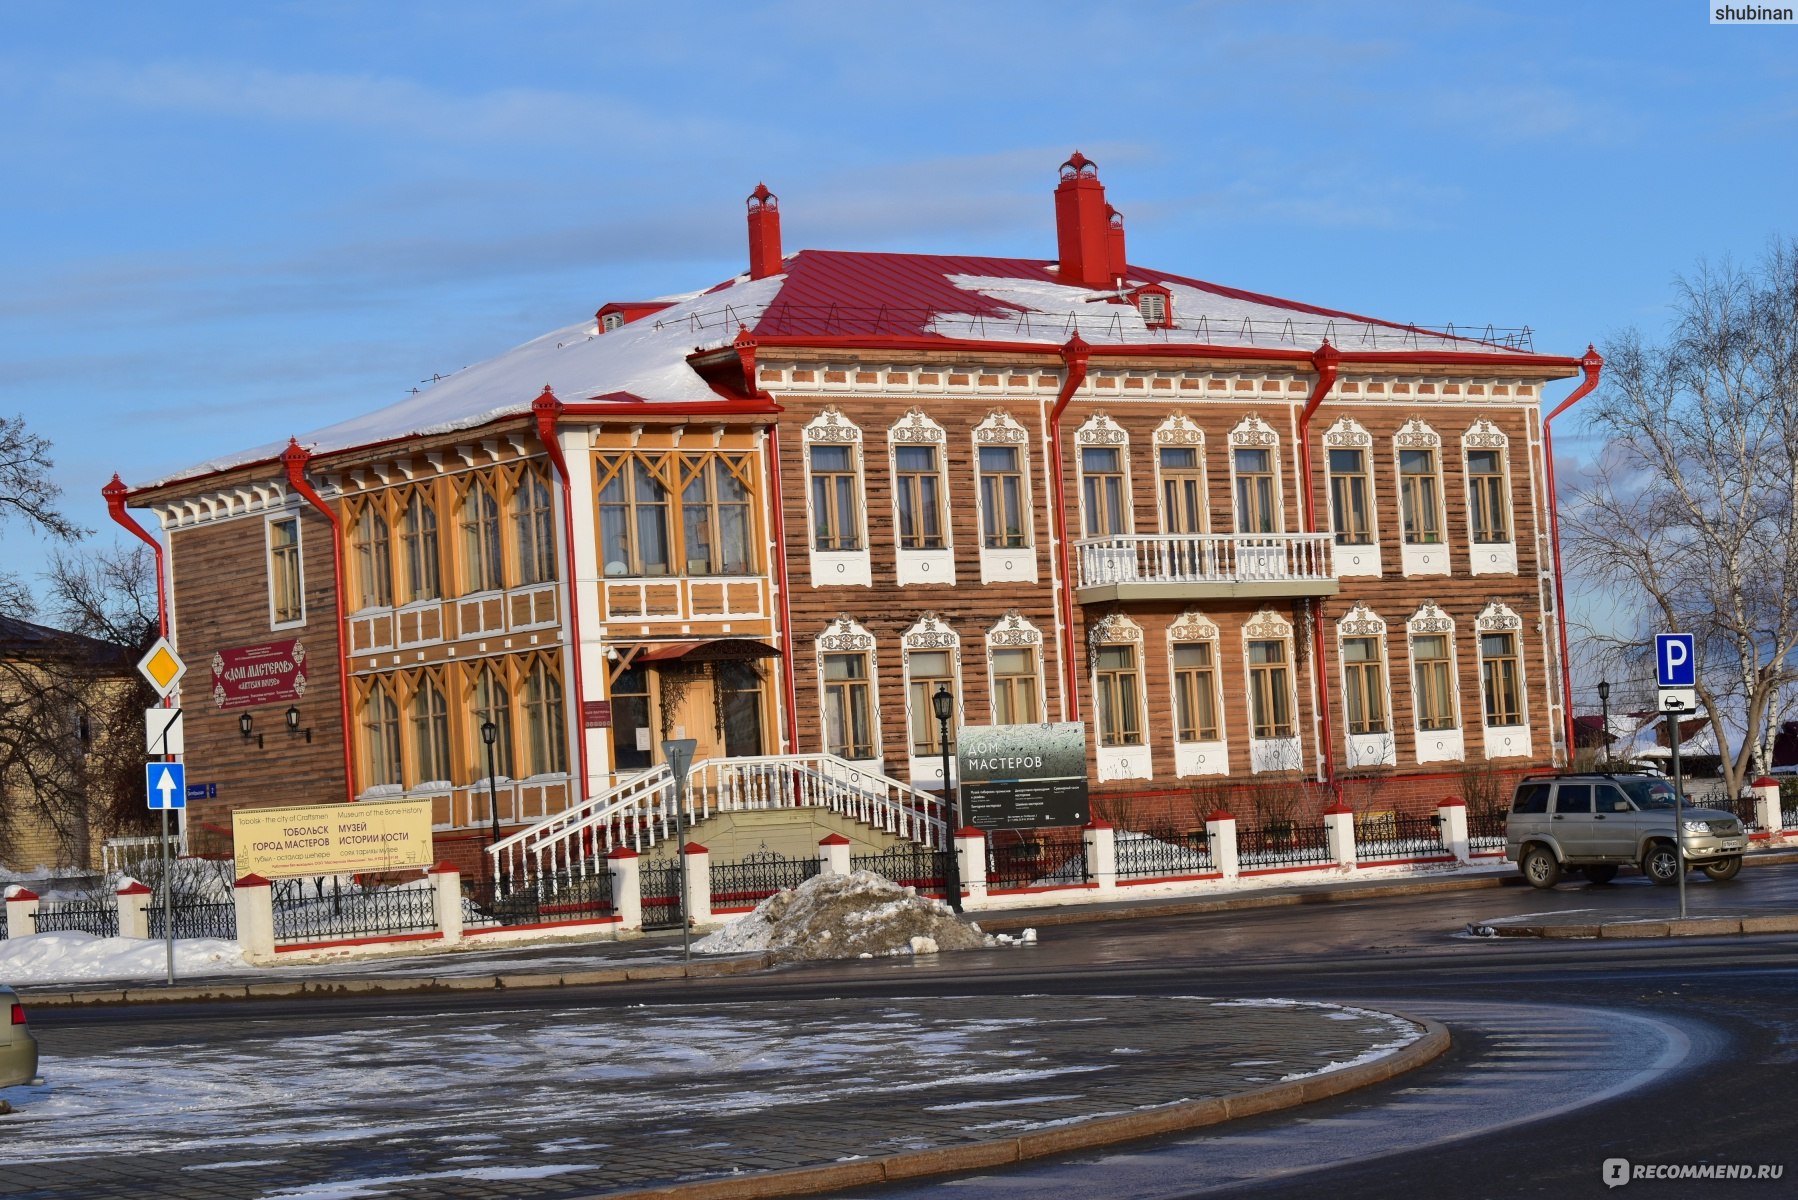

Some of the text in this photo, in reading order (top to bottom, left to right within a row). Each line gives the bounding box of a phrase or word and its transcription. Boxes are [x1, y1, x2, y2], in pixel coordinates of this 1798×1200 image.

[1667, 639, 1687, 680] P
[247, 660, 294, 678] МАСТЕРОВ»
[968, 742, 998, 756] ДОМ
[969, 756, 1042, 771] МАСТЕРОВ
[277, 815, 288, 824] city
[289, 814, 296, 822] of
[296, 813, 329, 821] Craftsmen
[337, 811, 365, 819] Museum
[384, 808, 402, 816] Bone
[402, 807, 423, 815] History
[283, 825, 329, 837] ТОБОЛЬСК
[338, 821, 367, 833] МУЗЕЙ
[252, 837, 330, 851] ГОРОД МАСТЕРОВ
[339, 832, 409, 845] ИСТОРИИ КОСТИ
